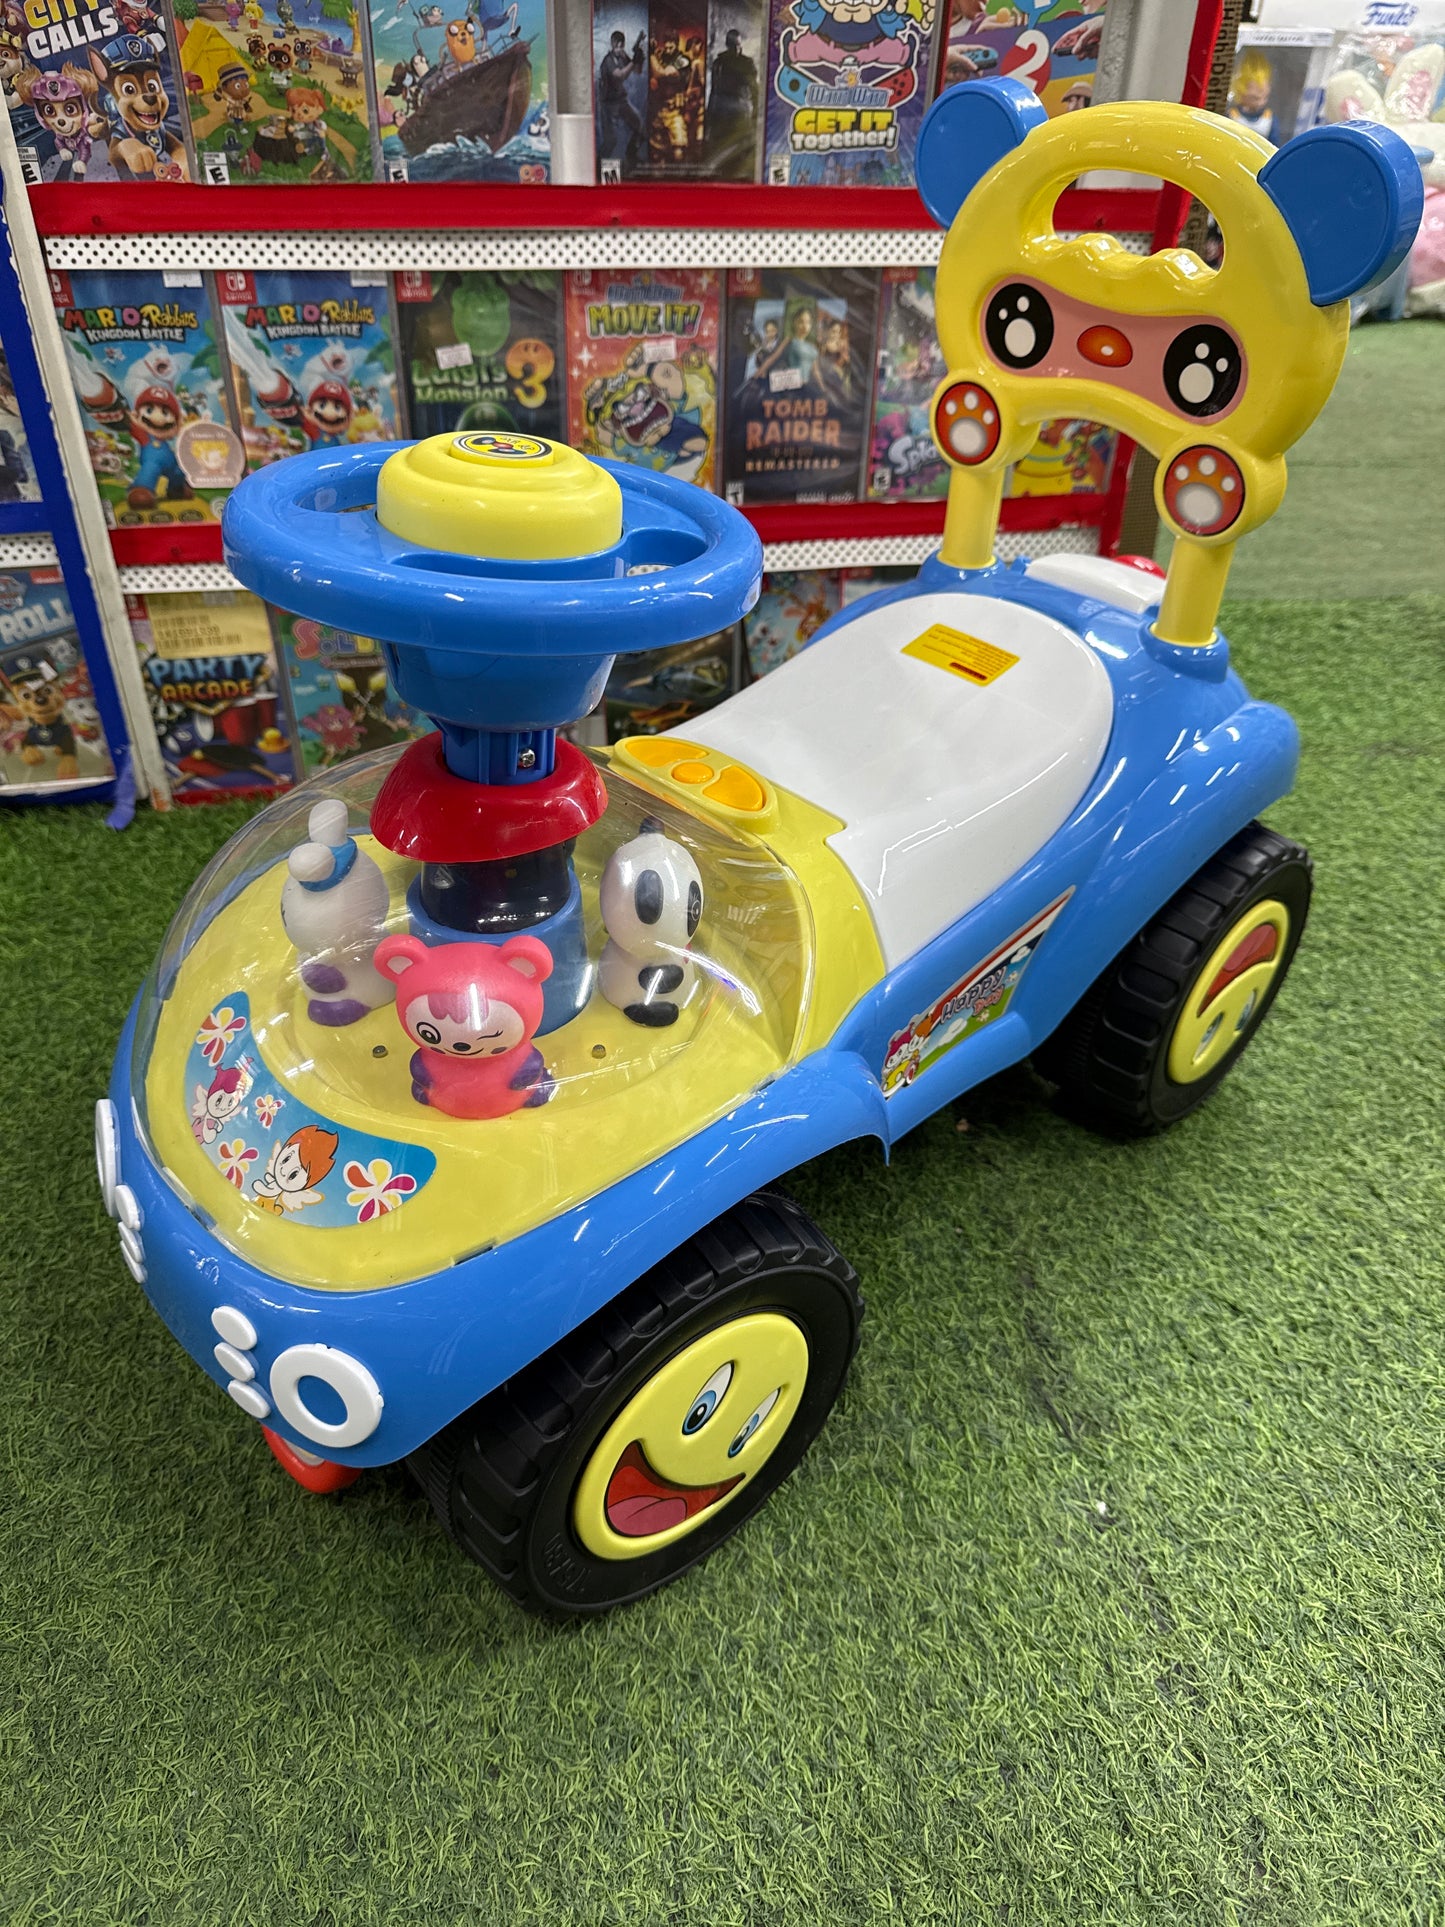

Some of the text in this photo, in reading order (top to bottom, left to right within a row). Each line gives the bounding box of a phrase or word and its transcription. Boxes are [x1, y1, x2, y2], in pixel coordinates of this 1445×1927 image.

[27, 7, 119, 59] CALLS
[1003, 29, 1049, 91] 2
[794, 109, 893, 134] GET IT
[21, 163, 38, 184] E
[209, 167, 226, 184] E
[64, 308, 141, 330] MARIO
[246, 303, 320, 326] MARIO
[588, 303, 701, 336] MOVE IT!
[86, 327, 185, 341] KINGDOM BATTLE
[267, 323, 361, 339] KINGDOM BATTLE
[505, 338, 555, 409] 3
[416, 385, 508, 401] Mansion
[762, 399, 828, 418] TOMB
[746, 420, 841, 451] RAIDER
[745, 458, 839, 472] REMASTERED
[149, 654, 266, 685] PARTY
[161, 681, 253, 700] ARCADE
